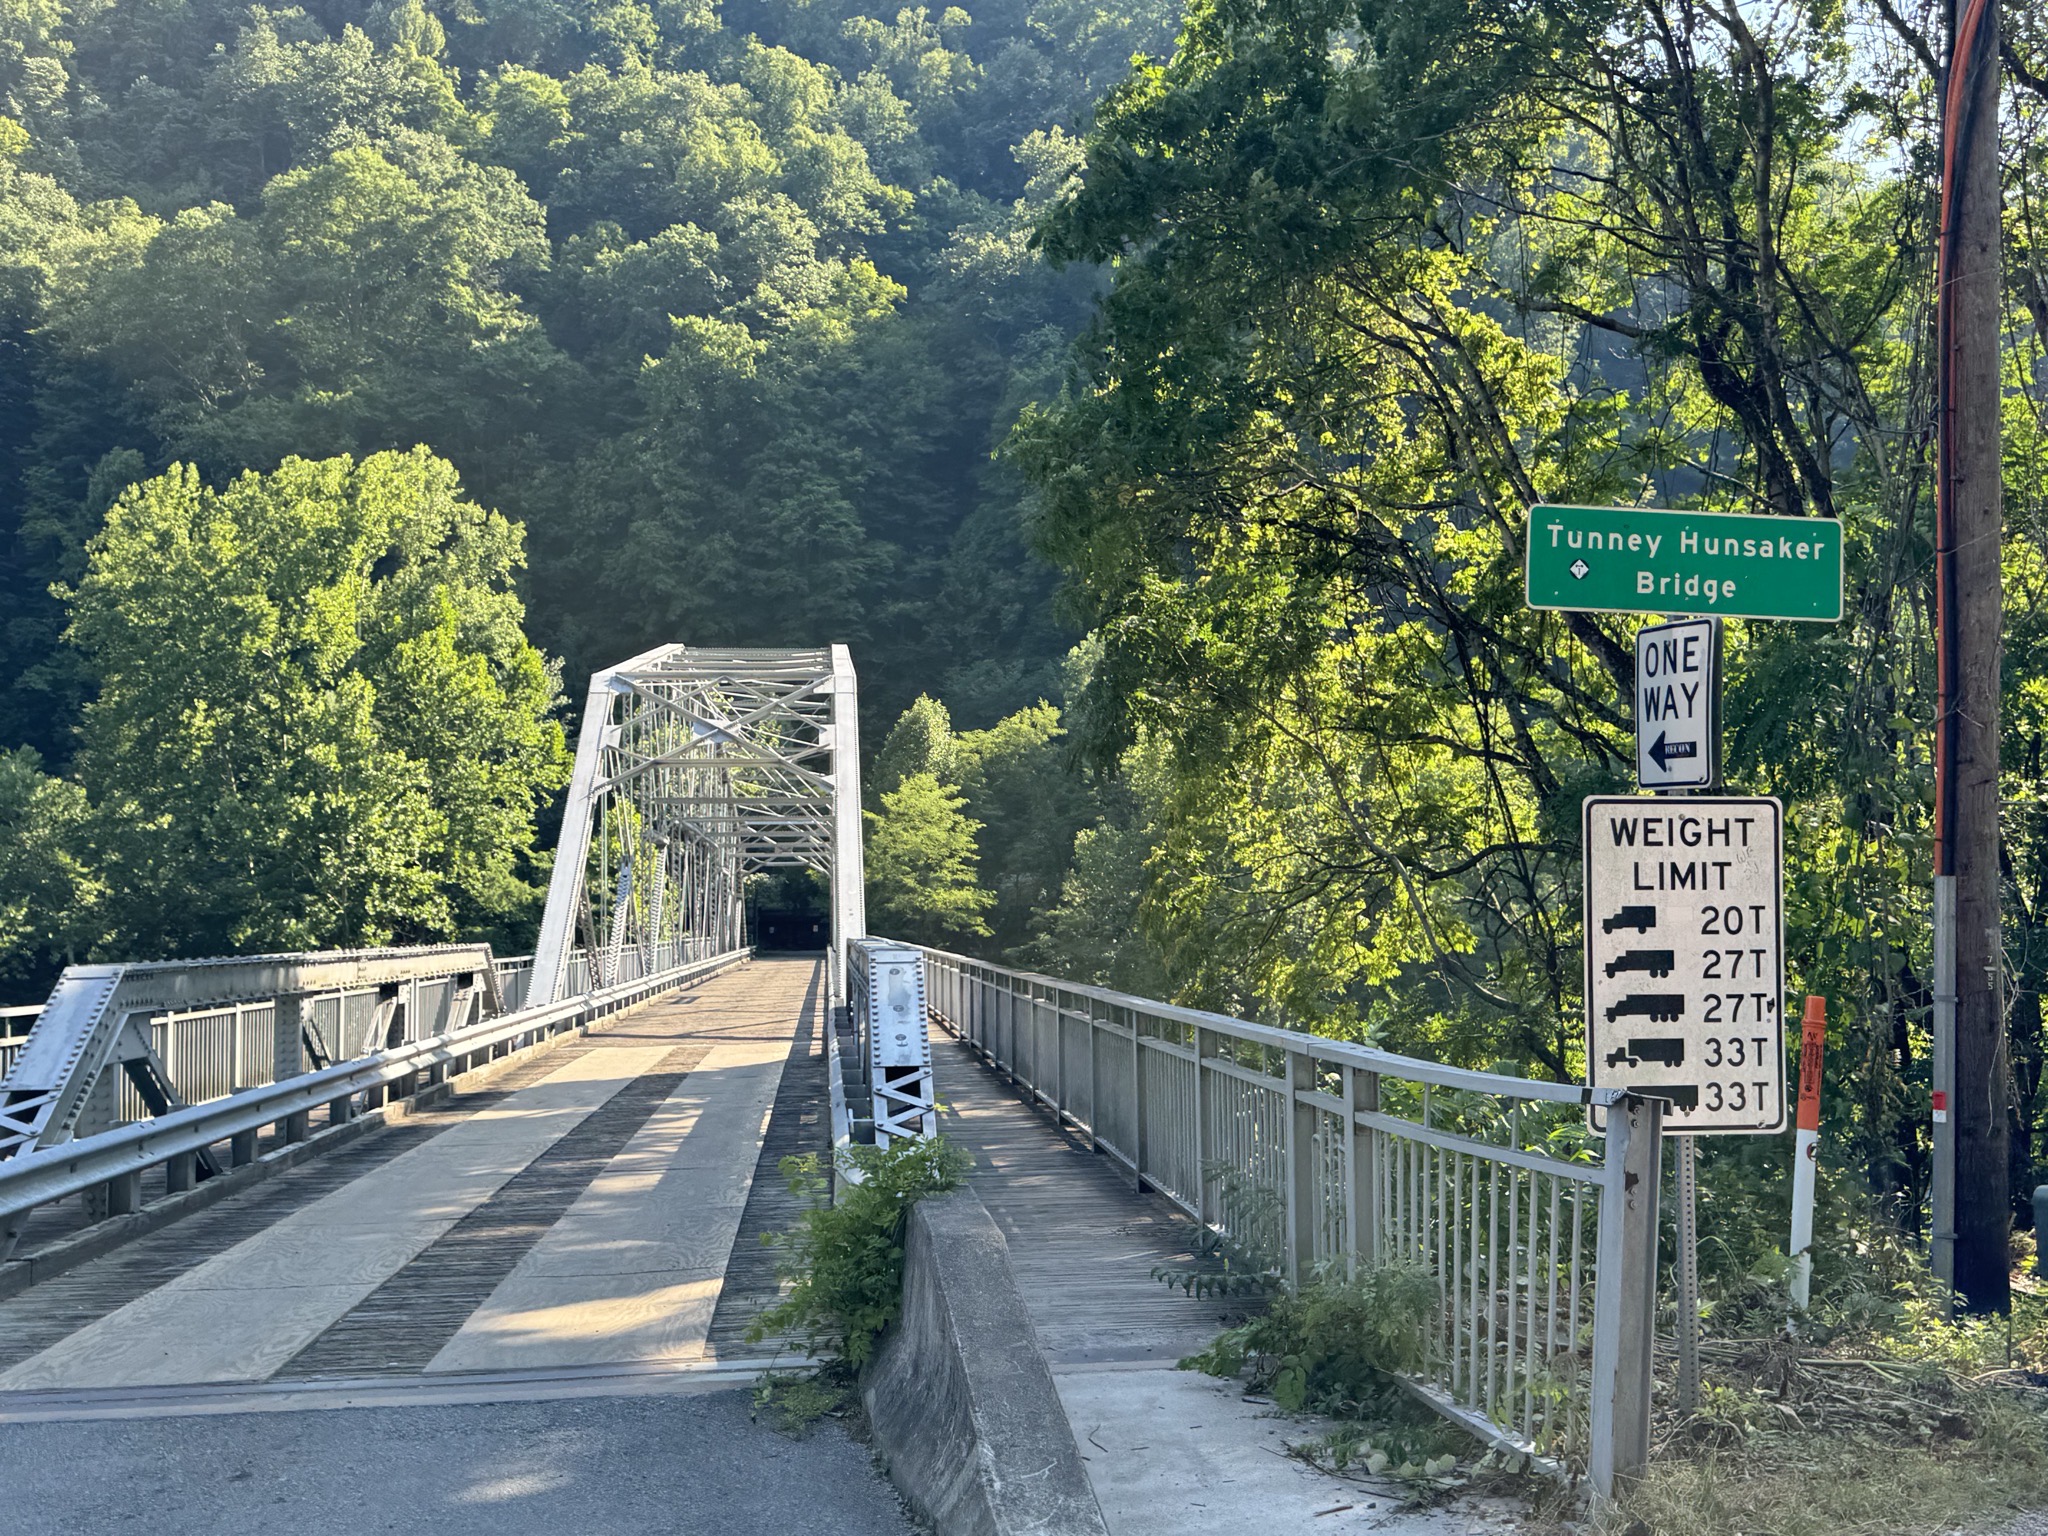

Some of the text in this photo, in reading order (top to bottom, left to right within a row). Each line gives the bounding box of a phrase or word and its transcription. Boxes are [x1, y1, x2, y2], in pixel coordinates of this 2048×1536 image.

[1547, 524, 1825, 560] Tunney Hunsaker
[1637, 571, 1736, 604] Bridge
[1645, 635, 1699, 678] ONE
[1644, 681, 1699, 722] WAY
[1610, 817, 1755, 847] WEIGHT
[1634, 862, 1732, 890] LIMIT
[1701, 905, 1766, 935] 20T
[1702, 950, 1767, 979] 27T
[1703, 993, 1768, 1023] 27T
[1704, 1037, 1768, 1067] 33T
[1705, 1082, 1769, 1112] 33T
